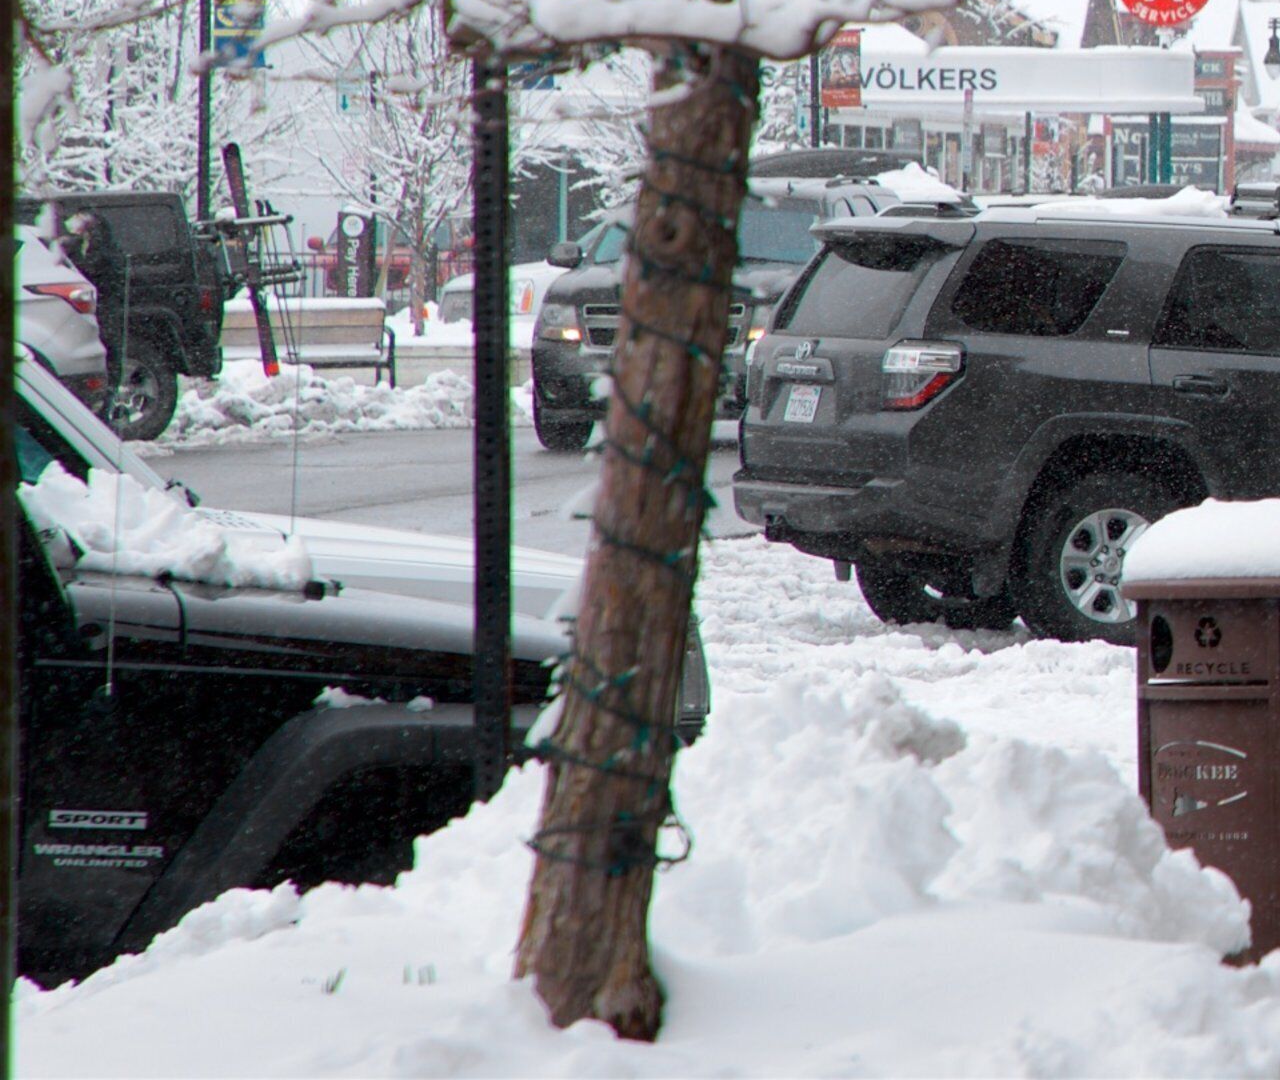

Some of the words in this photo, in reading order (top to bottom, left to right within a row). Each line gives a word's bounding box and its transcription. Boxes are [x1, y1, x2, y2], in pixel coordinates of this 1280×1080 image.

[1132, 1, 1196, 23] SERVICE
[859, 62, 998, 91] VÖLKERS
[1177, 663, 1251, 676] RECYCLE
[55, 812, 142, 827] SPORT
[34, 843, 163, 858] WRANGLER
[53, 858, 148, 868] UNLIMITED
